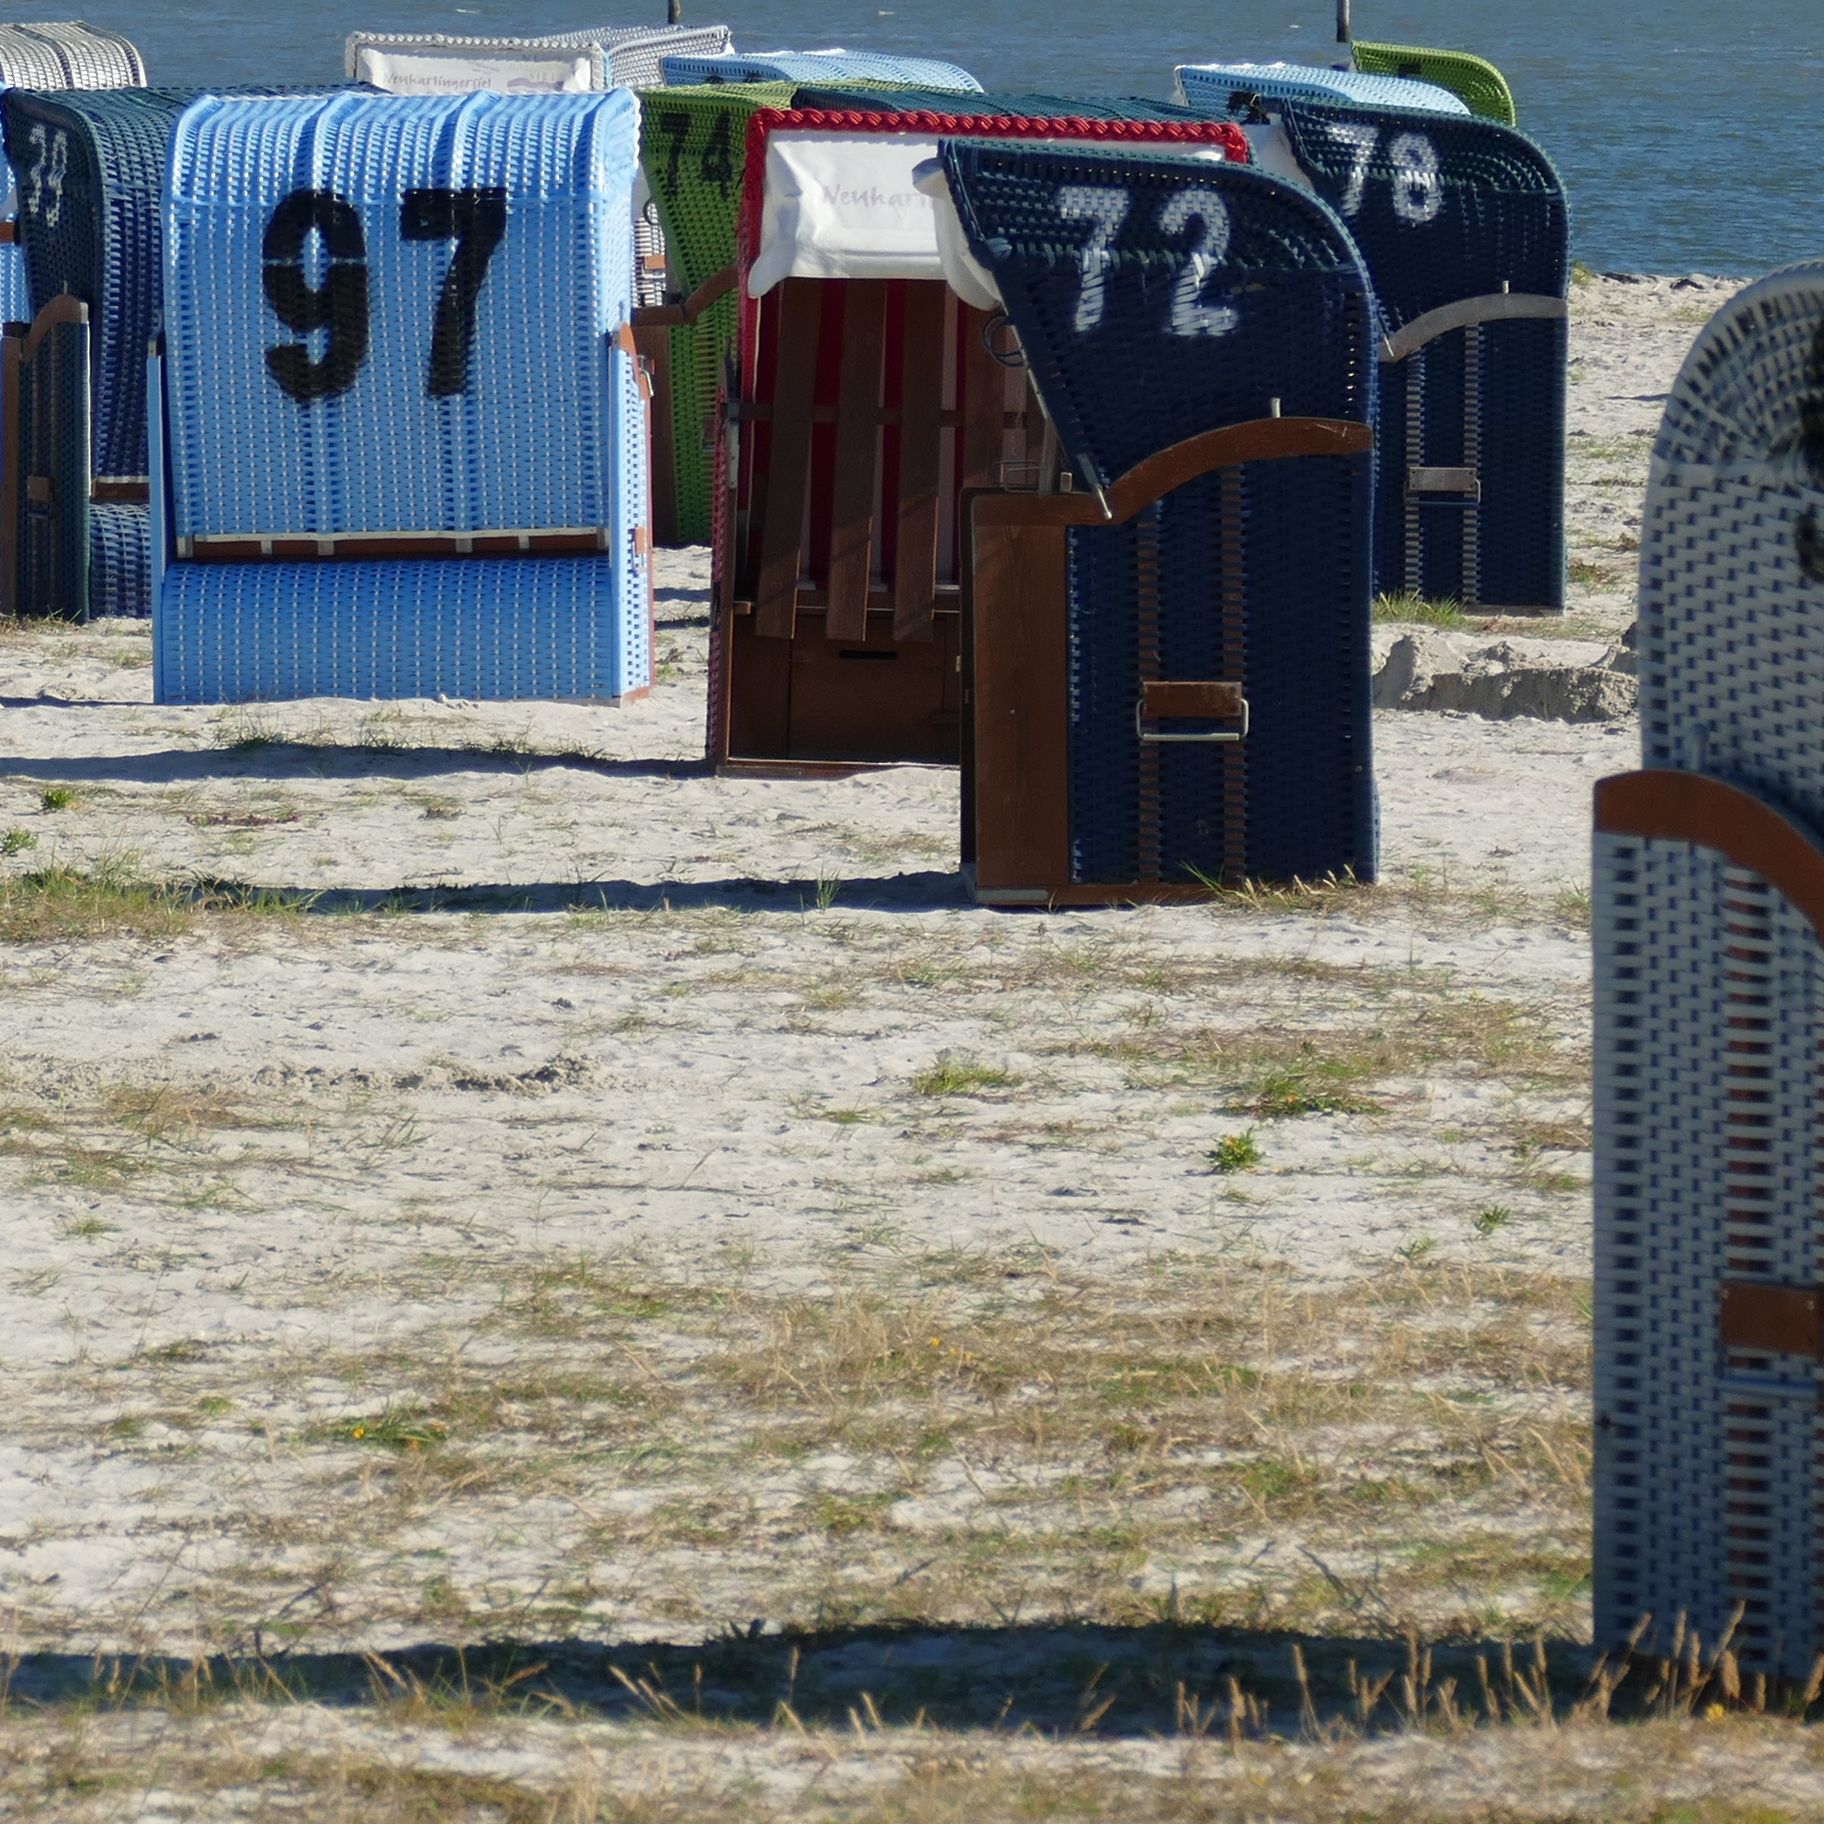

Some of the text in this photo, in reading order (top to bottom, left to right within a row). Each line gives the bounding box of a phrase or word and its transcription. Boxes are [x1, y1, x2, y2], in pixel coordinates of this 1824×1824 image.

[29, 124, 68, 228] 39
[660, 112, 733, 202] 74
[1326, 124, 1442, 223] 78
[262, 186, 509, 403] 97
[1058, 185, 1239, 336] 72
